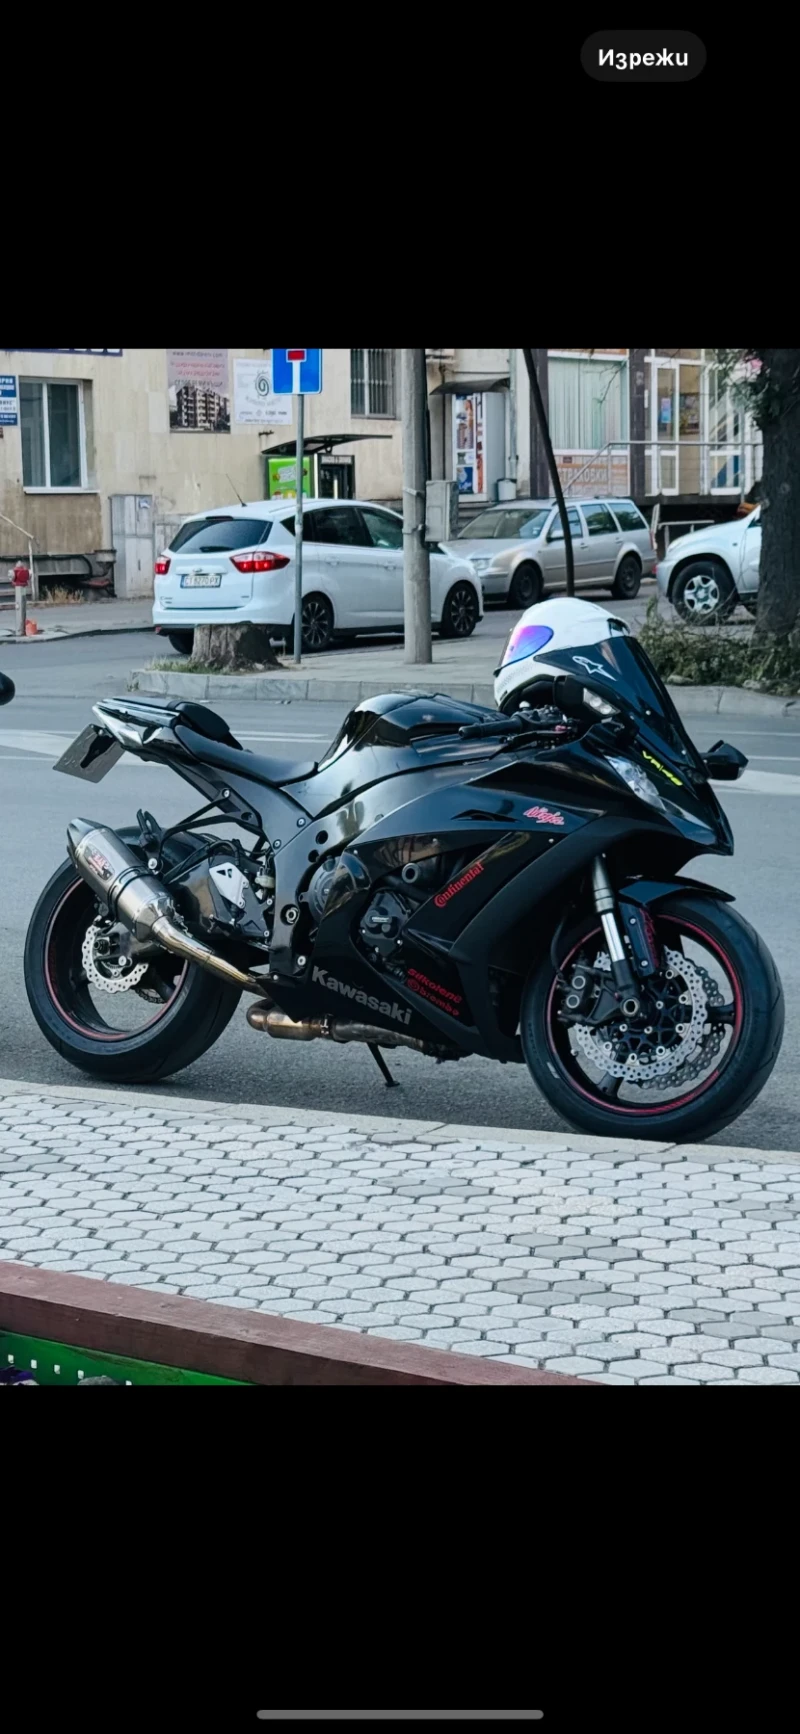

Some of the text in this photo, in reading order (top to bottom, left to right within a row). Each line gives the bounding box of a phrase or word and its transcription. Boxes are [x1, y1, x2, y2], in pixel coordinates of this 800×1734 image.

[523, 806, 565, 825] Ninja
[434, 861, 485, 908] Continental
[311, 965, 413, 1025] Kawasaki
